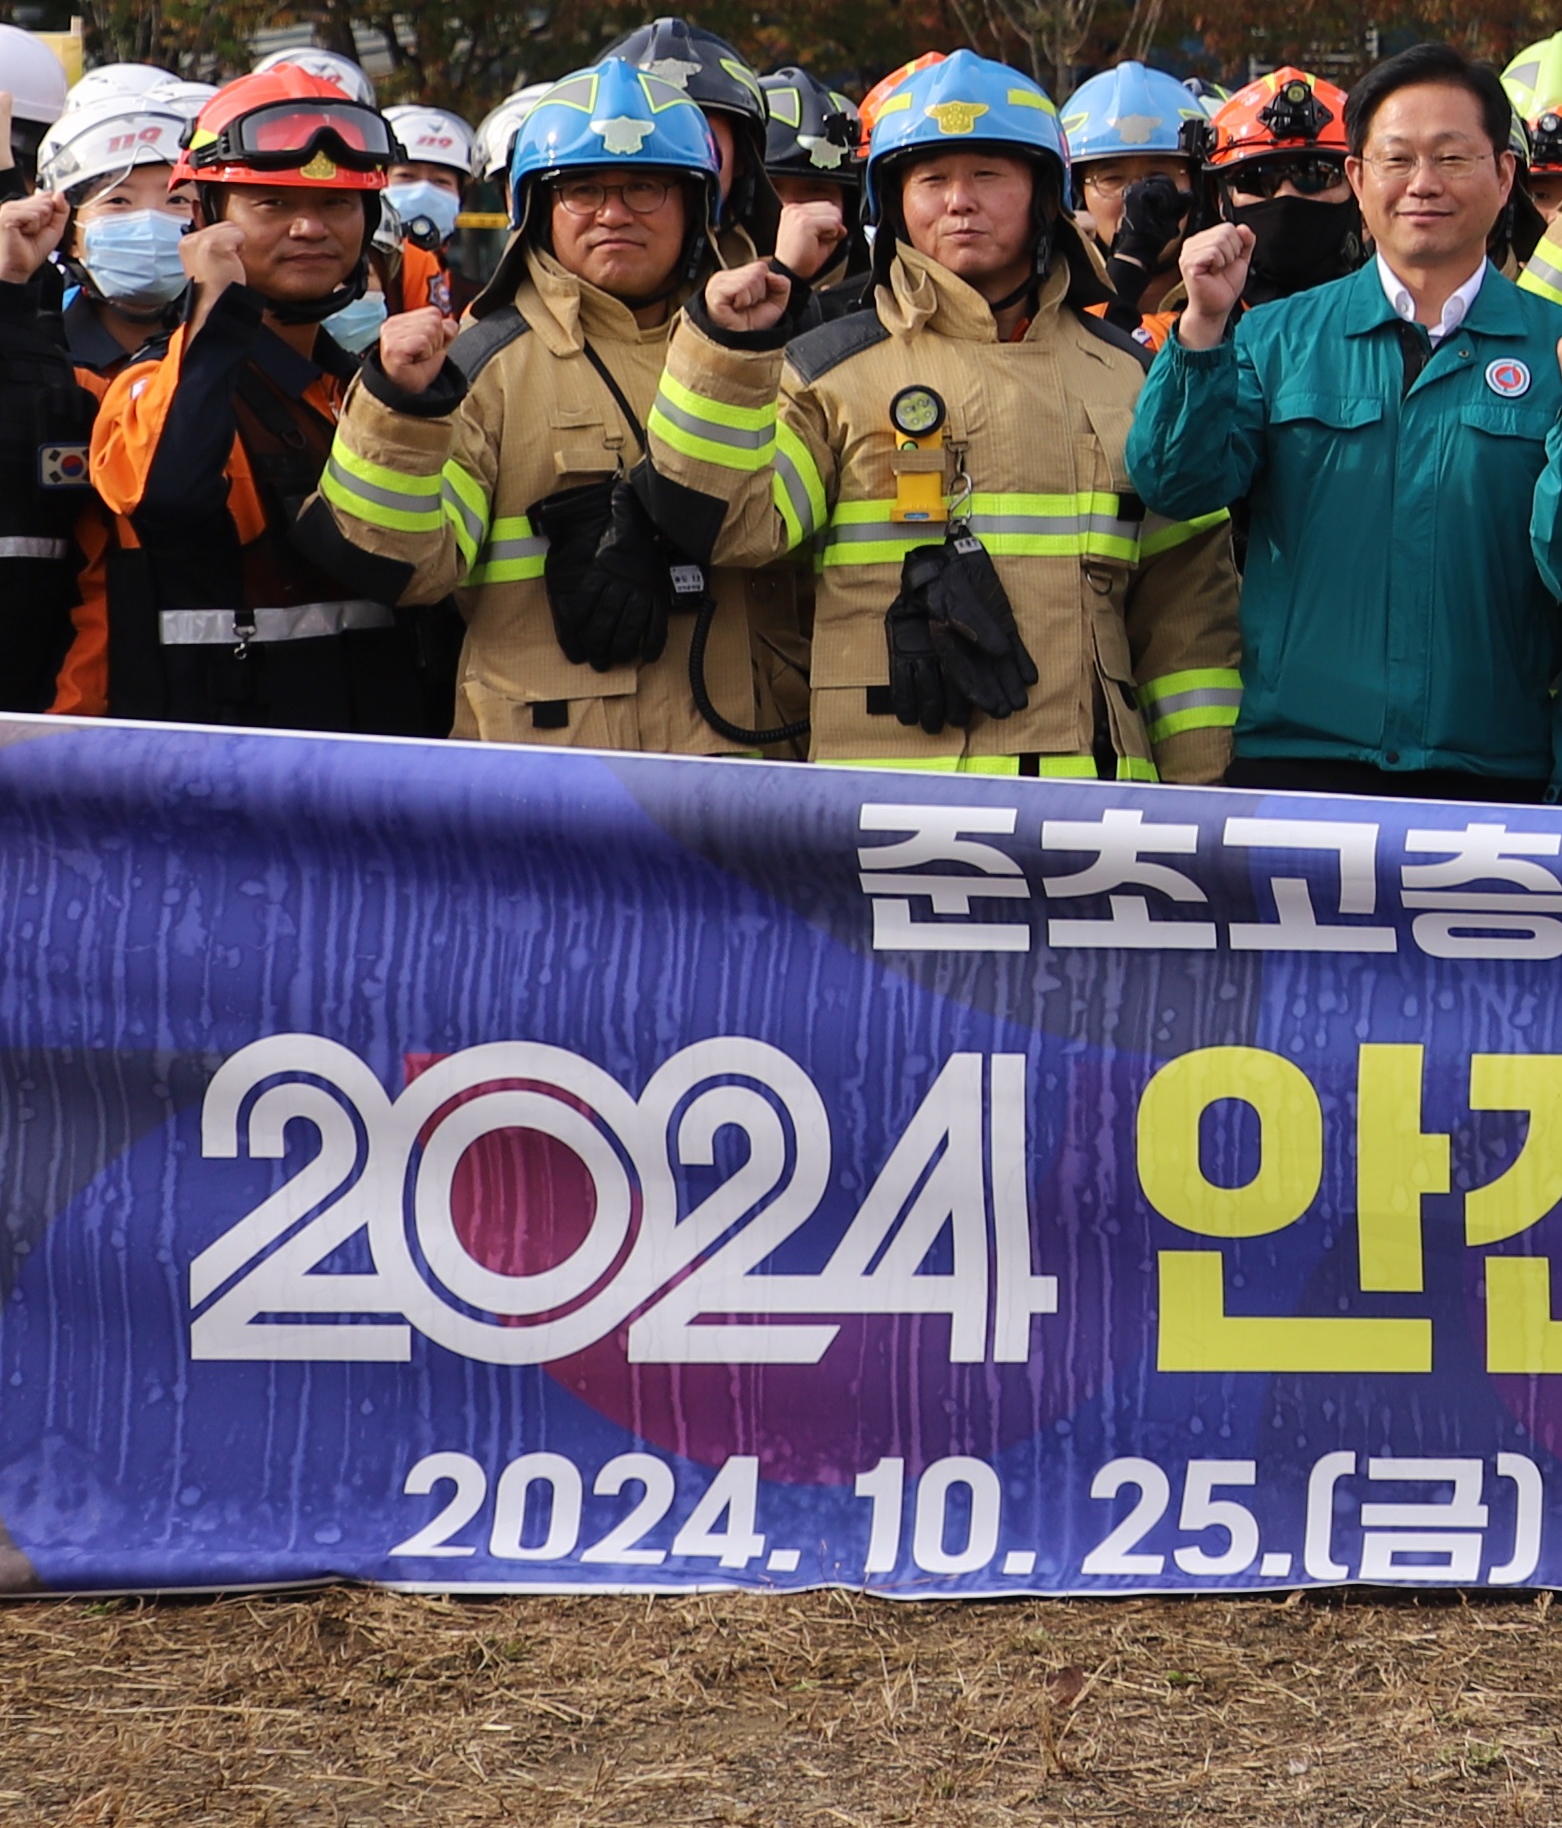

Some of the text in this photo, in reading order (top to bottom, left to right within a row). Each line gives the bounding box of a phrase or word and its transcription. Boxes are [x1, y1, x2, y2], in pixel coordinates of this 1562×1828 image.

[108, 127, 163, 154] 119
[416, 135, 454, 151] 119
[188, 1032, 1060, 1366] 2024
[387, 1449, 803, 1571] 2024.
[853, 1456, 1034, 1578] 10.
